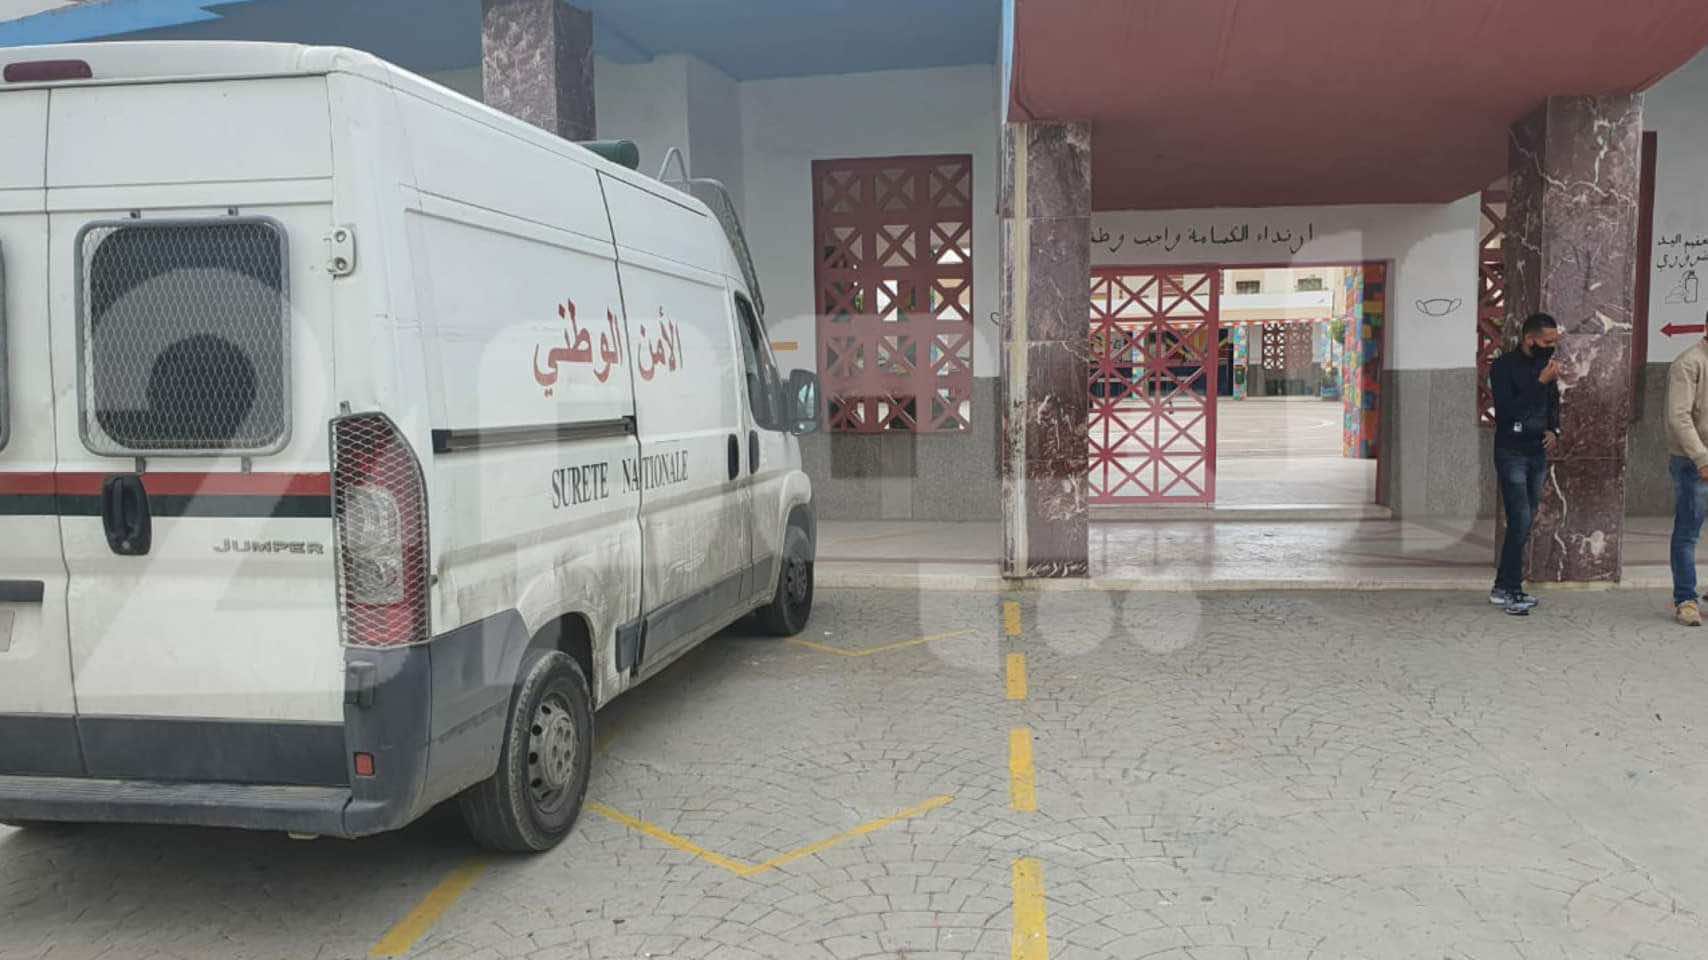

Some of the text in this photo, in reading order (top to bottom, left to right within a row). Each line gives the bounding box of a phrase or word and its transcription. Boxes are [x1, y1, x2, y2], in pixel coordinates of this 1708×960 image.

[1133, 225, 1181, 252] واجب
[1187, 223, 1249, 245] الكمامة
[533, 297, 684, 398] الأمن الوطني
[551, 450, 689, 509] SURETE NATIONALE
[212, 538, 325, 555] JUMPER
